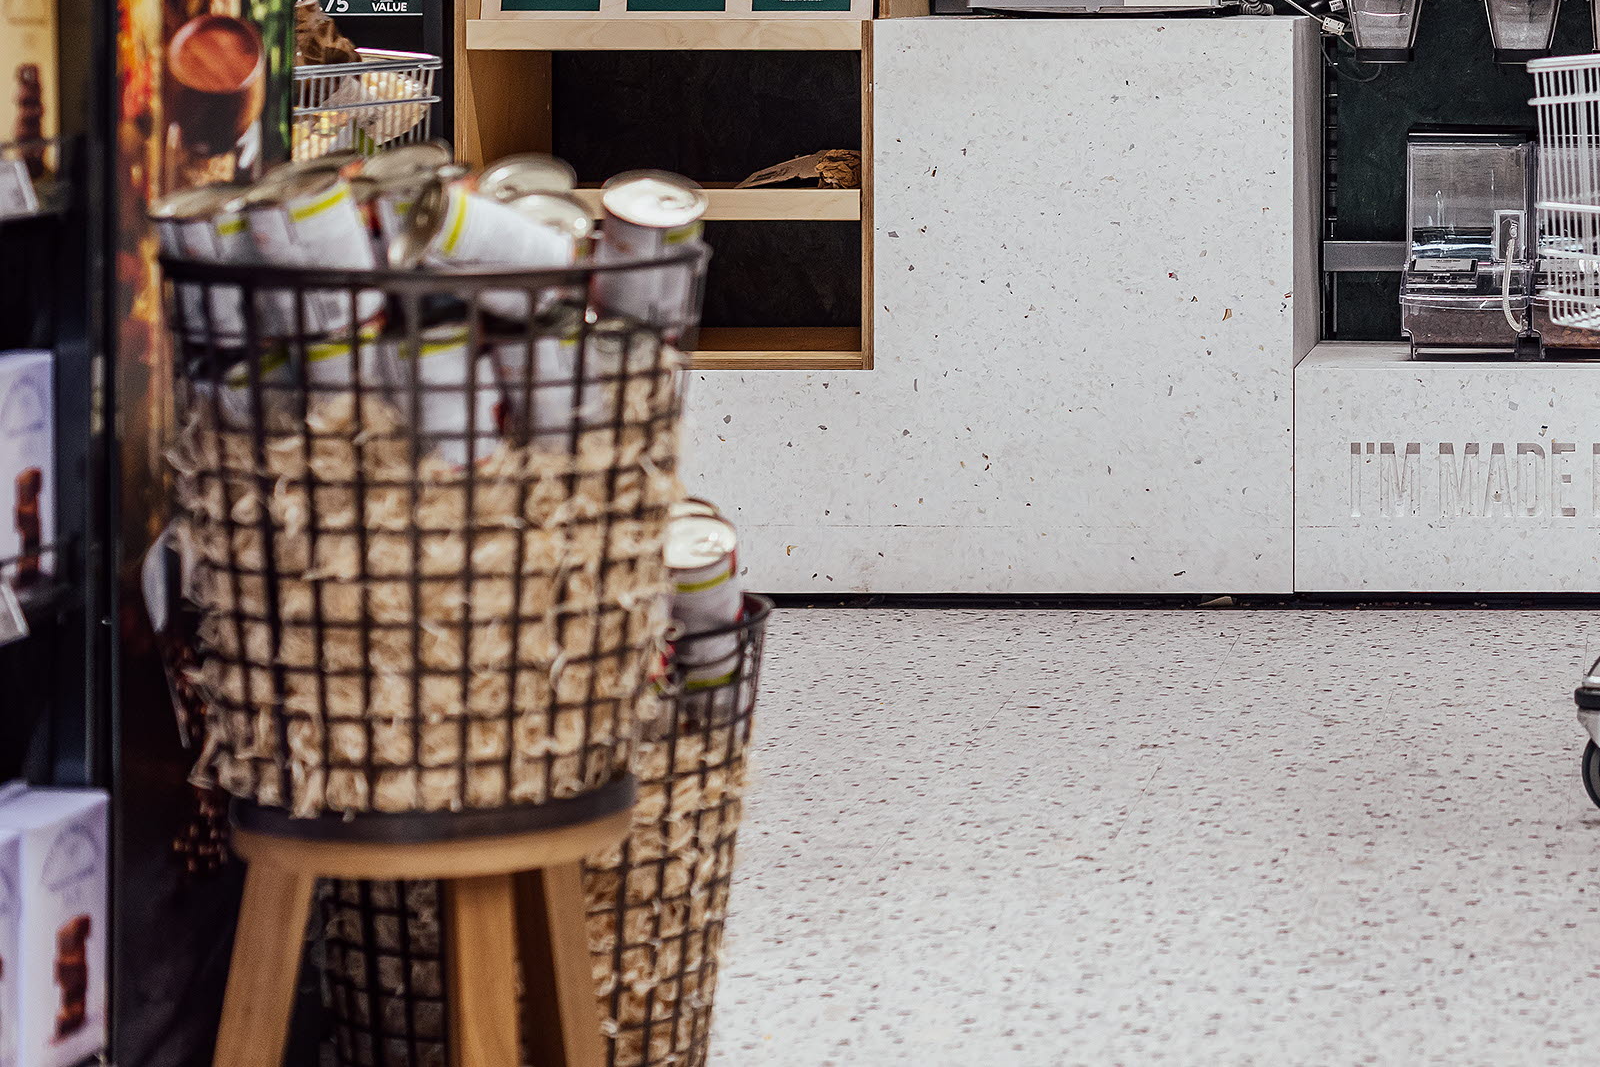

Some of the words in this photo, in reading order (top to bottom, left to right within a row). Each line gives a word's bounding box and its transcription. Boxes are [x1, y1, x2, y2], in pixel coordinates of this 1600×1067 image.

[372, 2, 407, 12] VALUE
[1350, 442, 1420, 517] I'M
[1439, 442, 1576, 517] MADE
